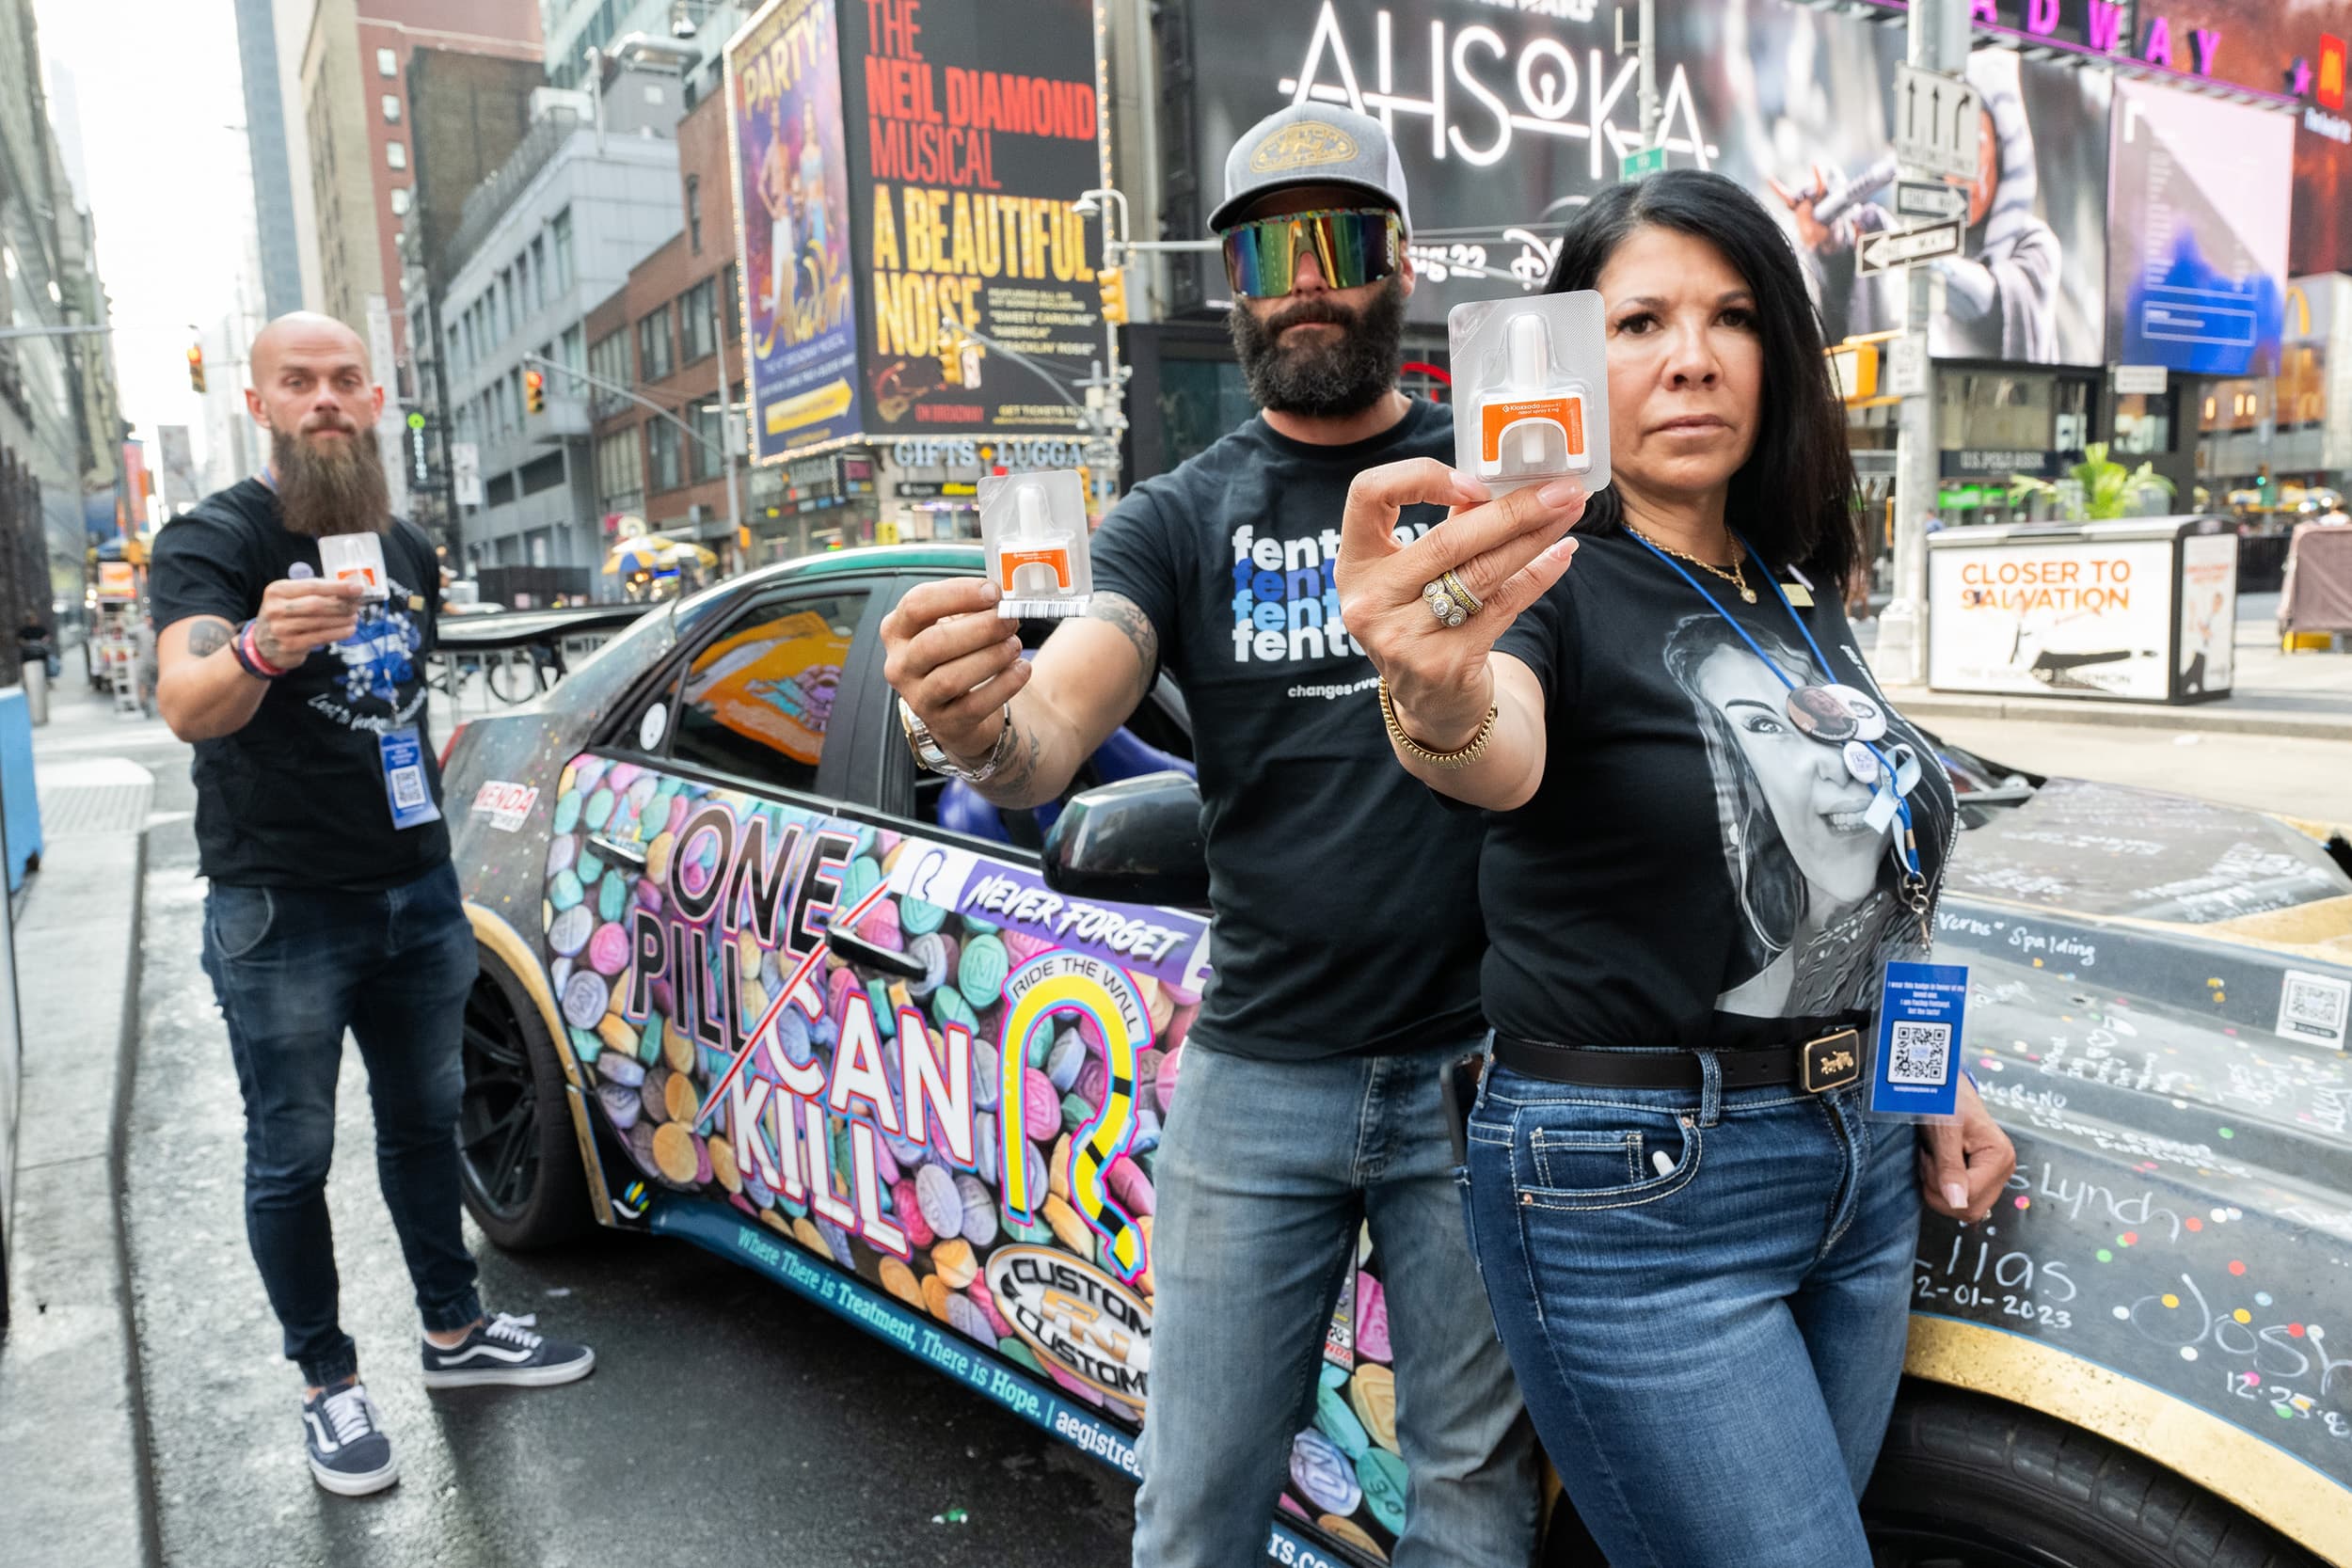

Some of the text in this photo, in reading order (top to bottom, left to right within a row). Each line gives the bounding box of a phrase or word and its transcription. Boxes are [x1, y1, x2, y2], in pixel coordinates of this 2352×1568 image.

[866, 0, 923, 60] THE
[866, 55, 1096, 140] NEIL DIAMOND
[1279, 3, 1720, 181] AHSOKA
[868, 119, 1002, 188] MUSICAL
[873, 183, 1095, 282] A BEAUTIFUL
[1409, 245, 1448, 282] ug
[1450, 244, 1486, 278] 22
[873, 271, 985, 358] NOISE
[895, 443, 1085, 467] GIFTS LUGGA
[1232, 557, 1338, 602] fent
[1232, 589, 1343, 632] fent
[1962, 560, 2131, 585] CLOSER TO
[1962, 587, 2130, 610] SALVATION
[1288, 681, 1353, 700] changes
[670, 806, 857, 956] ONE
[963, 873, 1189, 961] NEVER FORGET
[628, 908, 750, 1055] PILL
[2009, 927, 2095, 966] Spalding
[1012, 958, 1137, 1033] RIDE THE WALL
[763, 974, 976, 1167] CAN
[731, 1072, 910, 1258] KILL
[2041, 1161, 2180, 1244] Lynch
[738, 1227, 778, 1268] Where
[780, 1251, 821, 1290] There
[819, 1272, 835, 1299] is
[838, 1281, 916, 1350] Treatment,
[922, 1329, 969, 1374] There
[971, 1356, 989, 1386] is
[990, 1370, 1042, 1418] Hope.
[1011, 1259, 1152, 1338] CUSTOM
[2130, 1273, 2352, 1395] Josh
[1325, 1340, 1353, 1361] NDA
